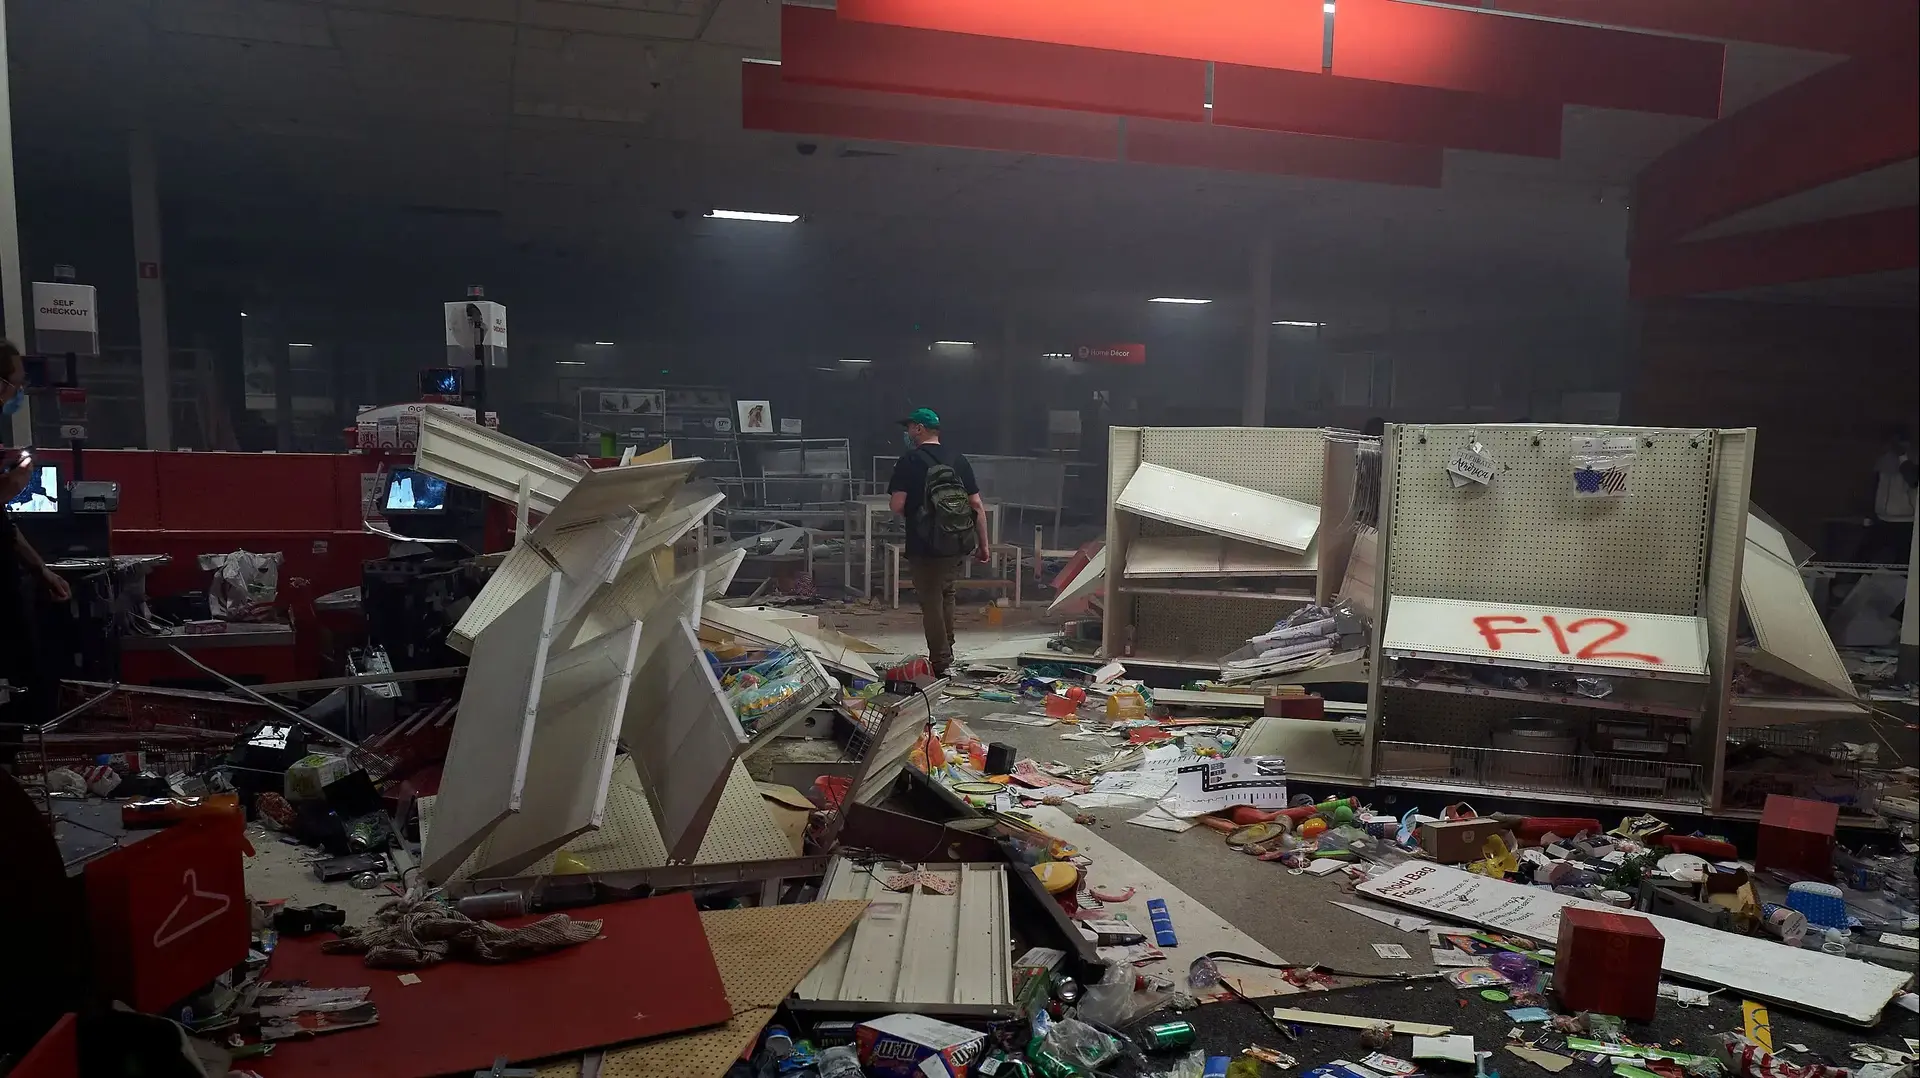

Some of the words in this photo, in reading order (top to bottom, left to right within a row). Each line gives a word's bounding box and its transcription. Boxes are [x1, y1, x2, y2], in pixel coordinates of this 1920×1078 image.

[40, 307, 88, 316] CHECKOUT
[1110, 348, 1130, 357] Décor
[1376, 879, 1412, 895] Avoid
[1404, 866, 1437, 881] Bag
[1392, 886, 1426, 899] Fees
